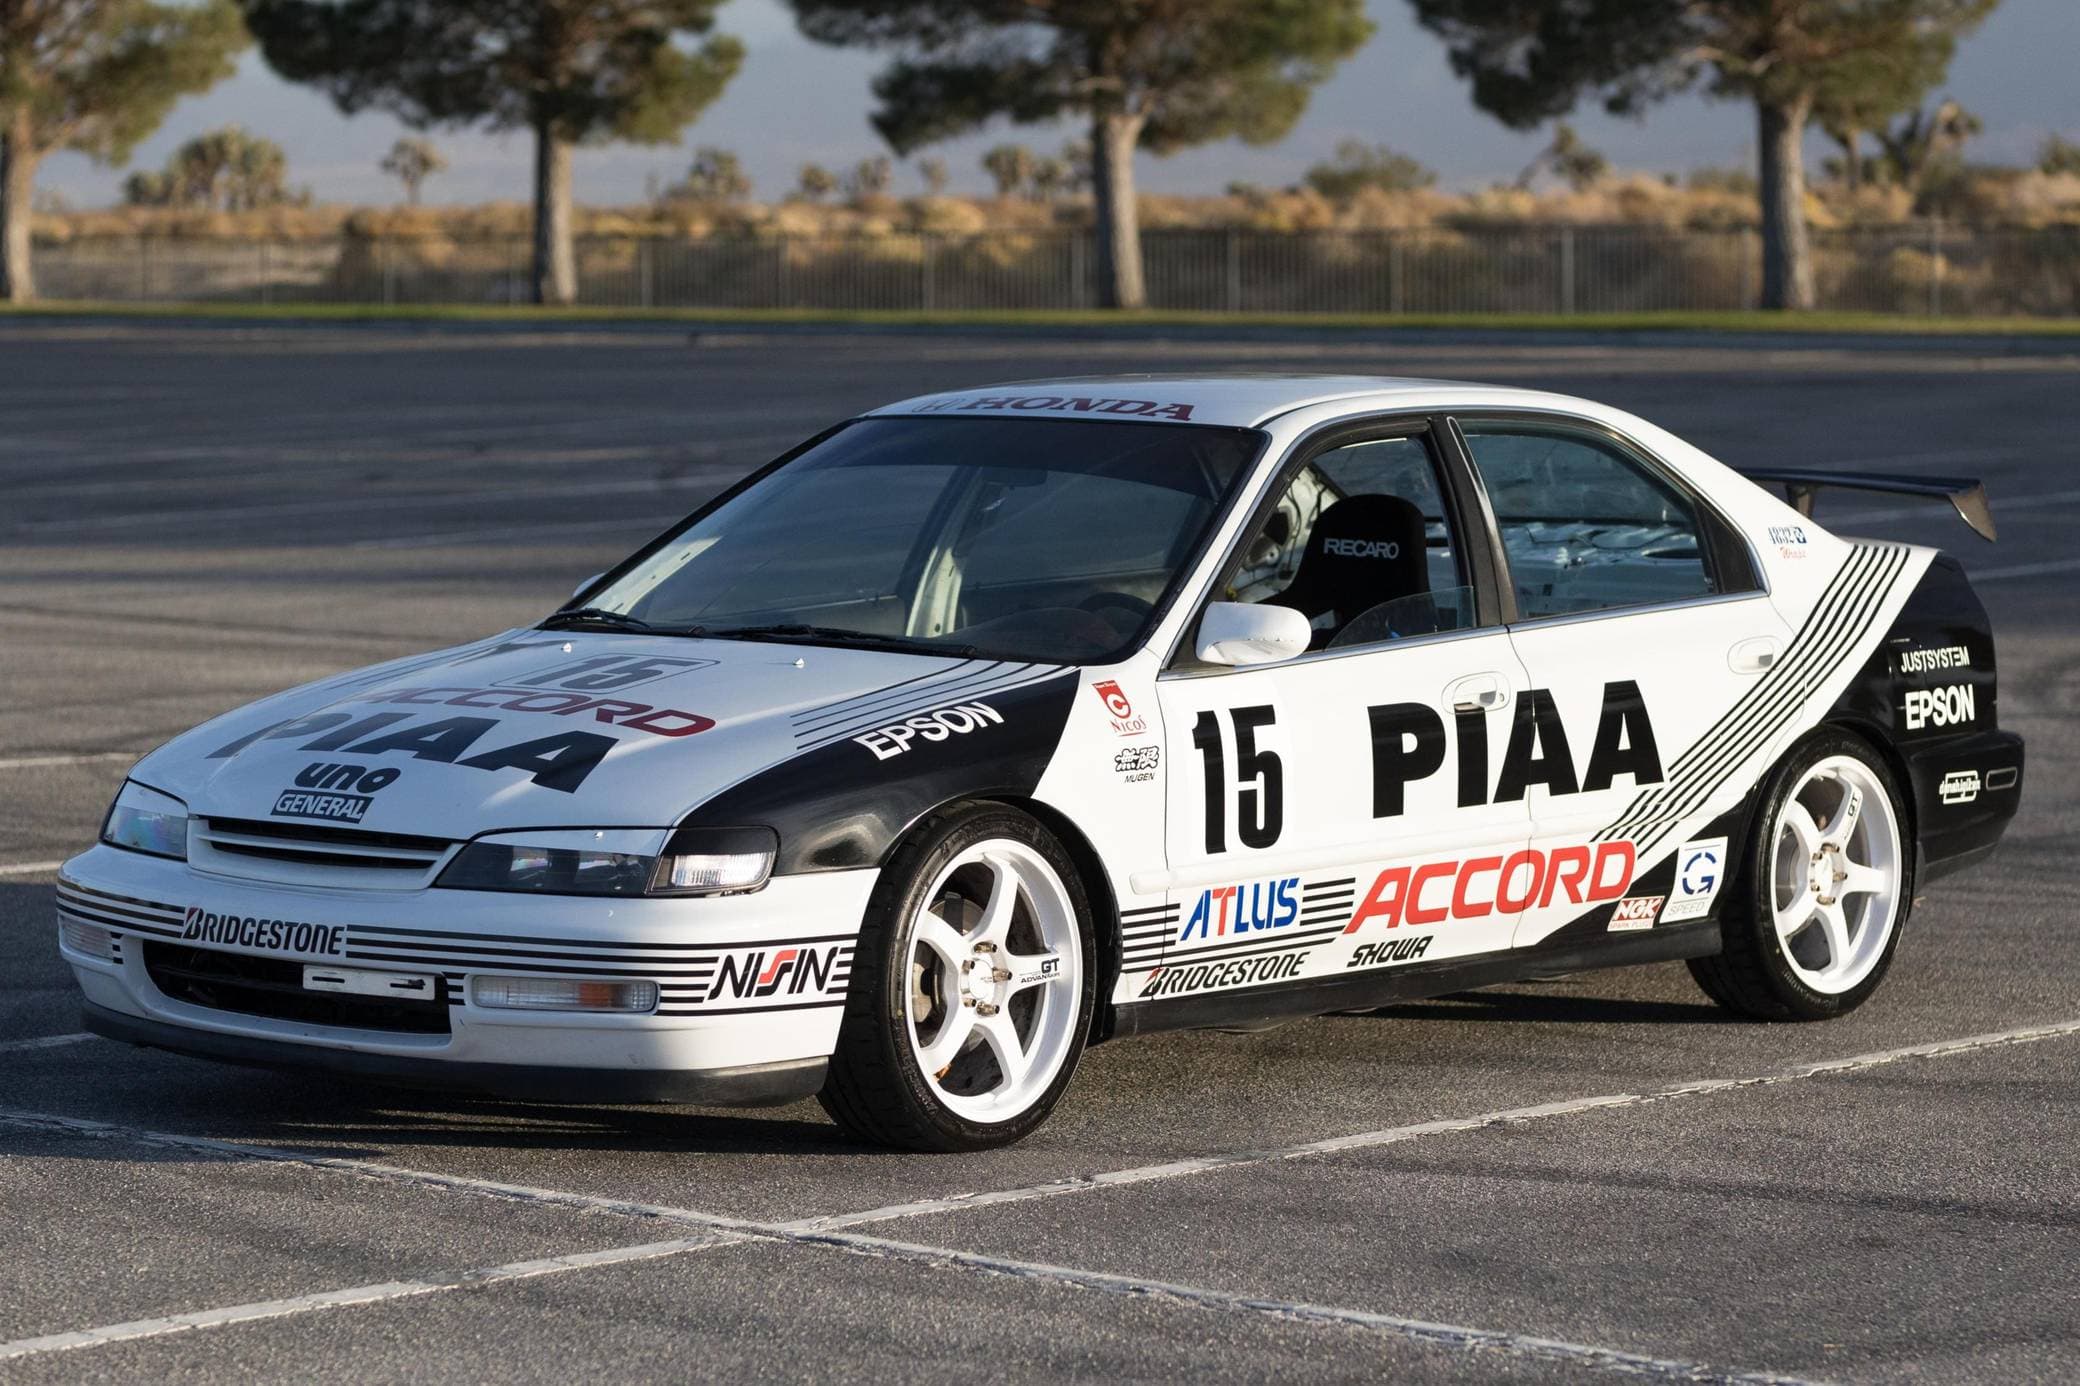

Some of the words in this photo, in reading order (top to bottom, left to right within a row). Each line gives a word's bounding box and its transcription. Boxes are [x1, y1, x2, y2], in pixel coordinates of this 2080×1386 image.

[957, 397, 1194, 422] HONDA
[1323, 537, 1400, 559] RECARO
[516, 655, 702, 690] 15
[1901, 645, 1970, 673] JUSTSYSTEM
[1905, 684, 1975, 730] EPSON
[852, 701, 1005, 760] EPSON
[205, 712, 620, 794] PIAA
[1114, 745, 1160, 772] 無限
[1366, 679, 1665, 820] PIAA
[1125, 773, 1155, 783] MUGEN
[1192, 704, 1284, 855] 15
[275, 793, 364, 819] GENERAL
[1343, 840, 1636, 935] ACCORD
[1180, 877, 1300, 941] ATLUS
[1614, 897, 1663, 921] NGK
[1667, 901, 1705, 916] SPEED
[183, 907, 345, 955] BRIDGESTONE
[1041, 957, 1060, 974] GT
[1347, 936, 1434, 968] SHOWA
[1021, 974, 1048, 984] ADVAN
[1139, 951, 1311, 998] BRIDGESTONE
